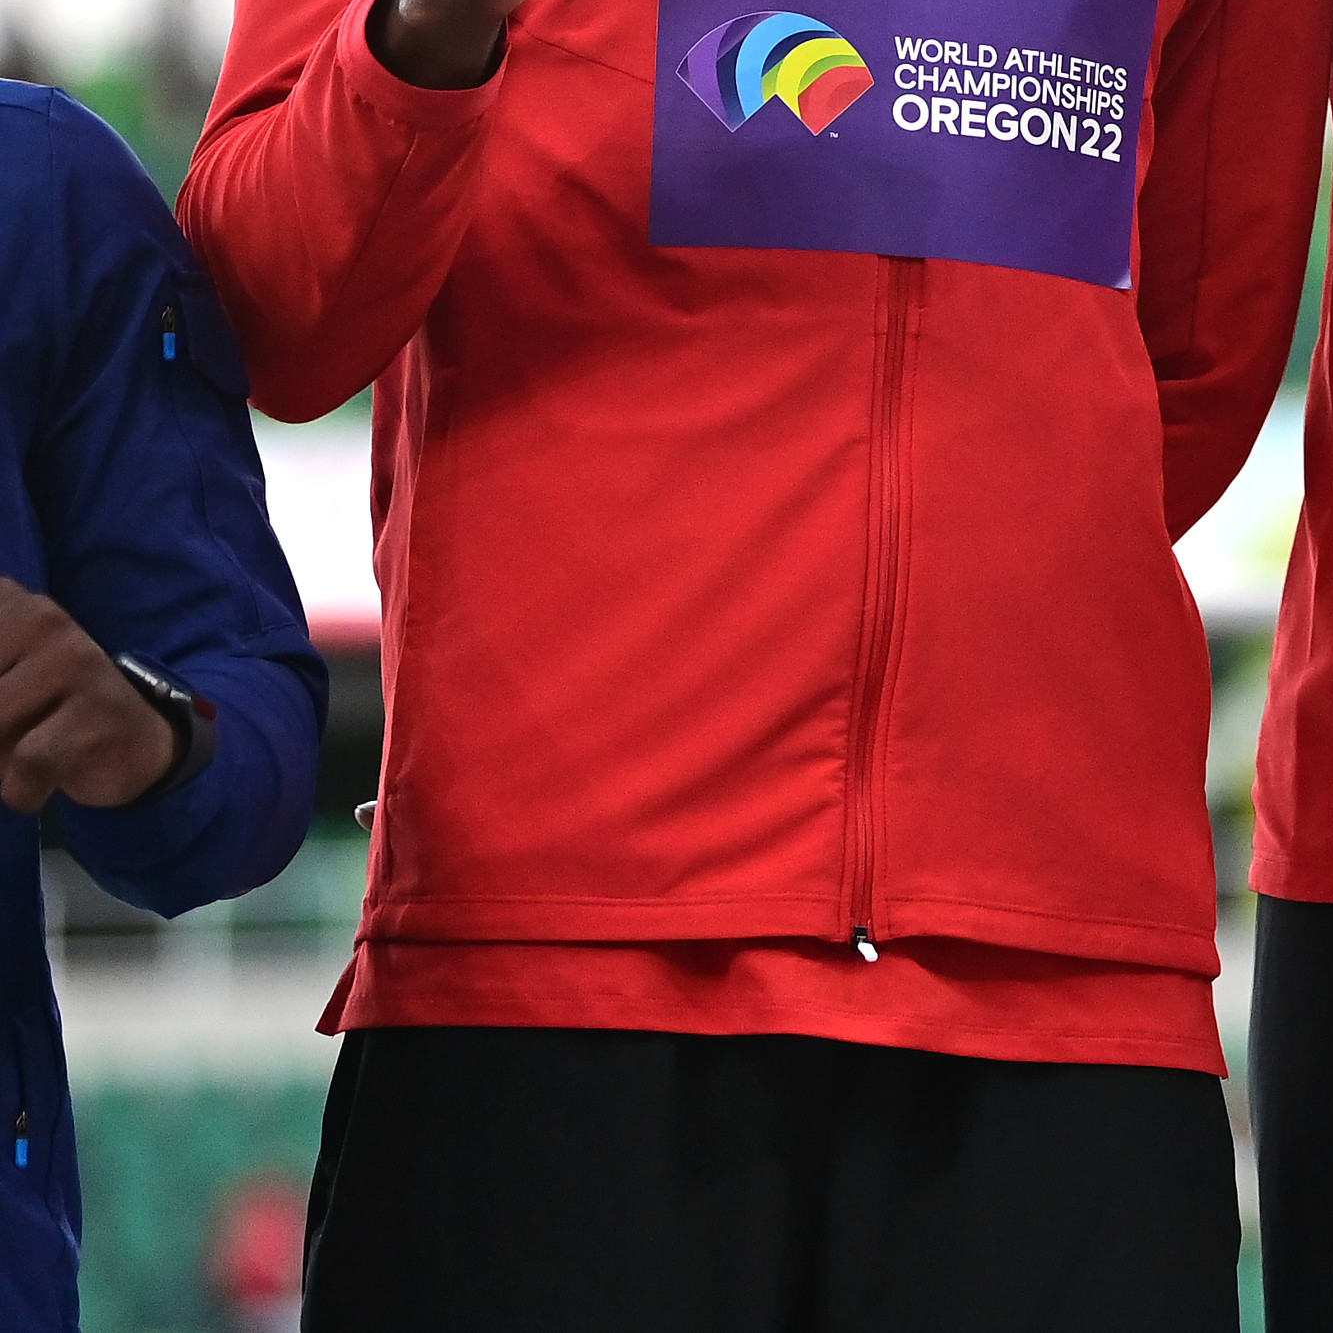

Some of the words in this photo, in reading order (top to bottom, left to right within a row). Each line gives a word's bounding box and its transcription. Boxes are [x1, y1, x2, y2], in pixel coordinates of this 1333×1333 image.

[894, 36, 998, 68] WORLD
[1003, 47, 1127, 92] ATHLETICS
[894, 64, 1124, 120] CHAMPIONSHIPS
[892, 94, 1122, 163] OREGON22
